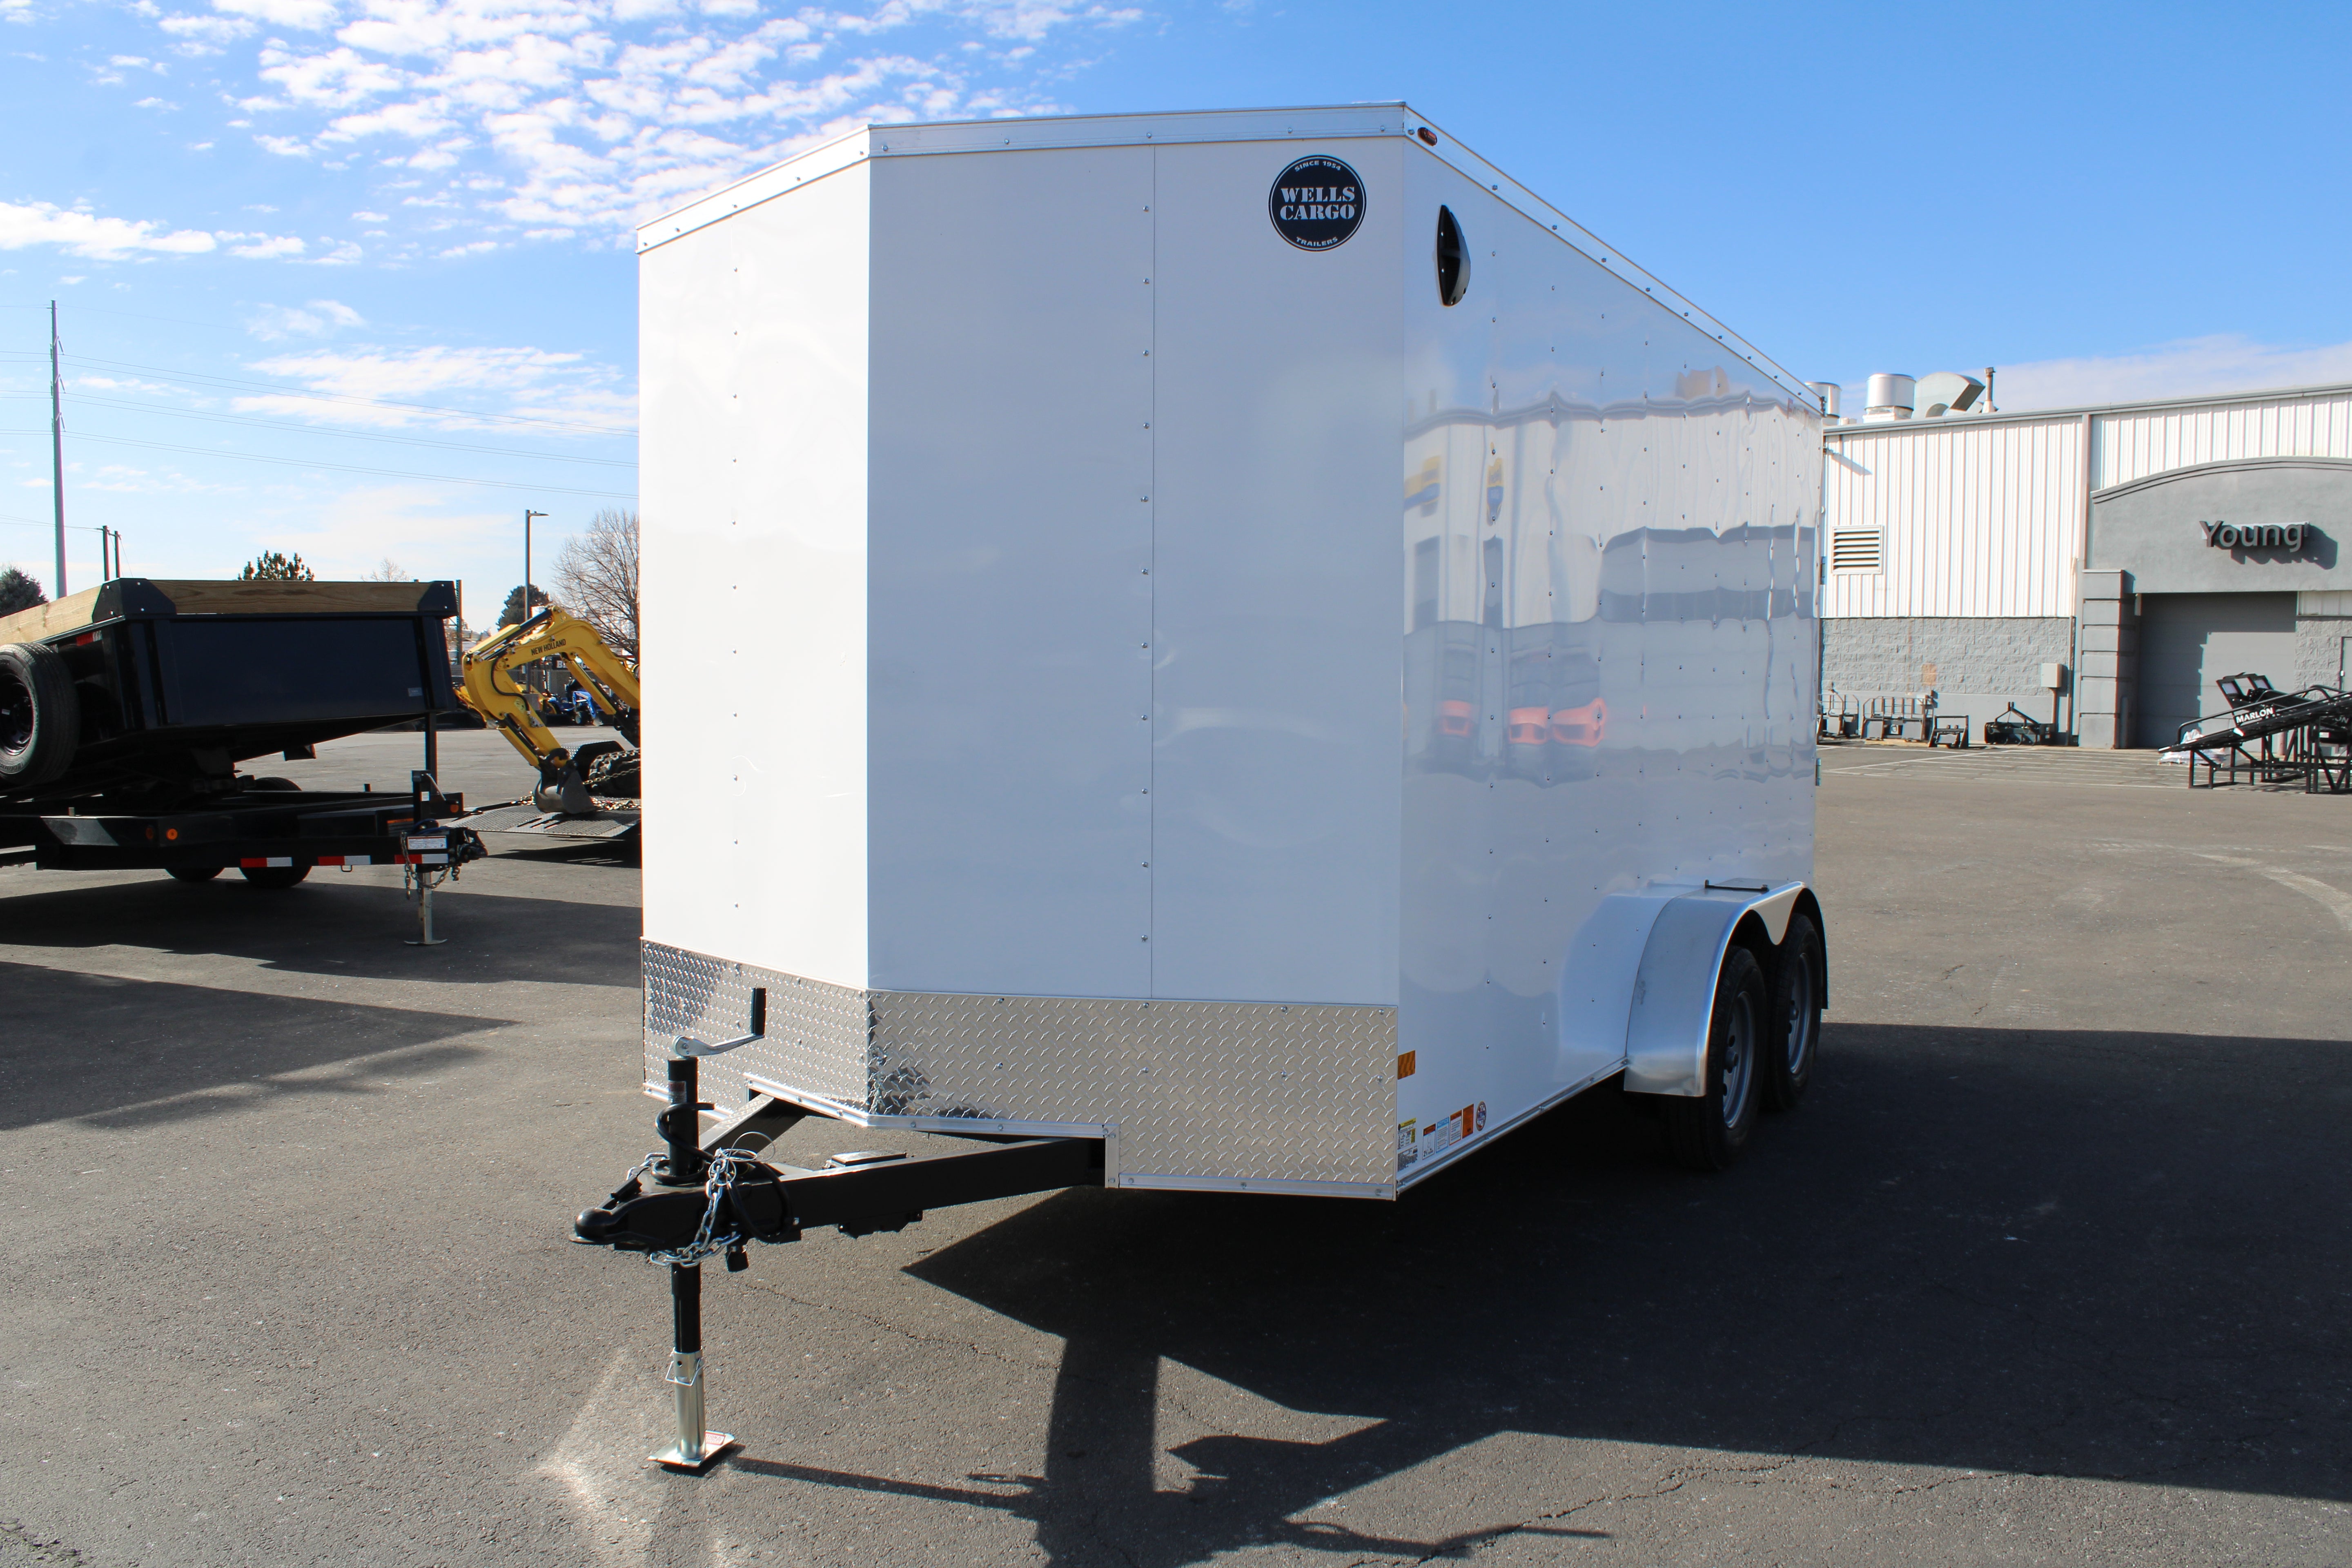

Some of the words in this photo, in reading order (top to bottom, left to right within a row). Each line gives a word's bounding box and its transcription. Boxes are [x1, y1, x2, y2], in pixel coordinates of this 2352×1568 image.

[1294, 160, 1319, 172] SINCE
[1323, 160, 1341, 171] 1954
[1281, 187, 1355, 203] WELLS
[1280, 204, 1355, 220] CARGO
[1296, 236, 1338, 247] TRAILERS
[2199, 521, 2304, 552] Young
[531, 646, 543, 655] NEW
[543, 639, 566, 651] HOLLAND
[2236, 707, 2274, 724] MARLON
